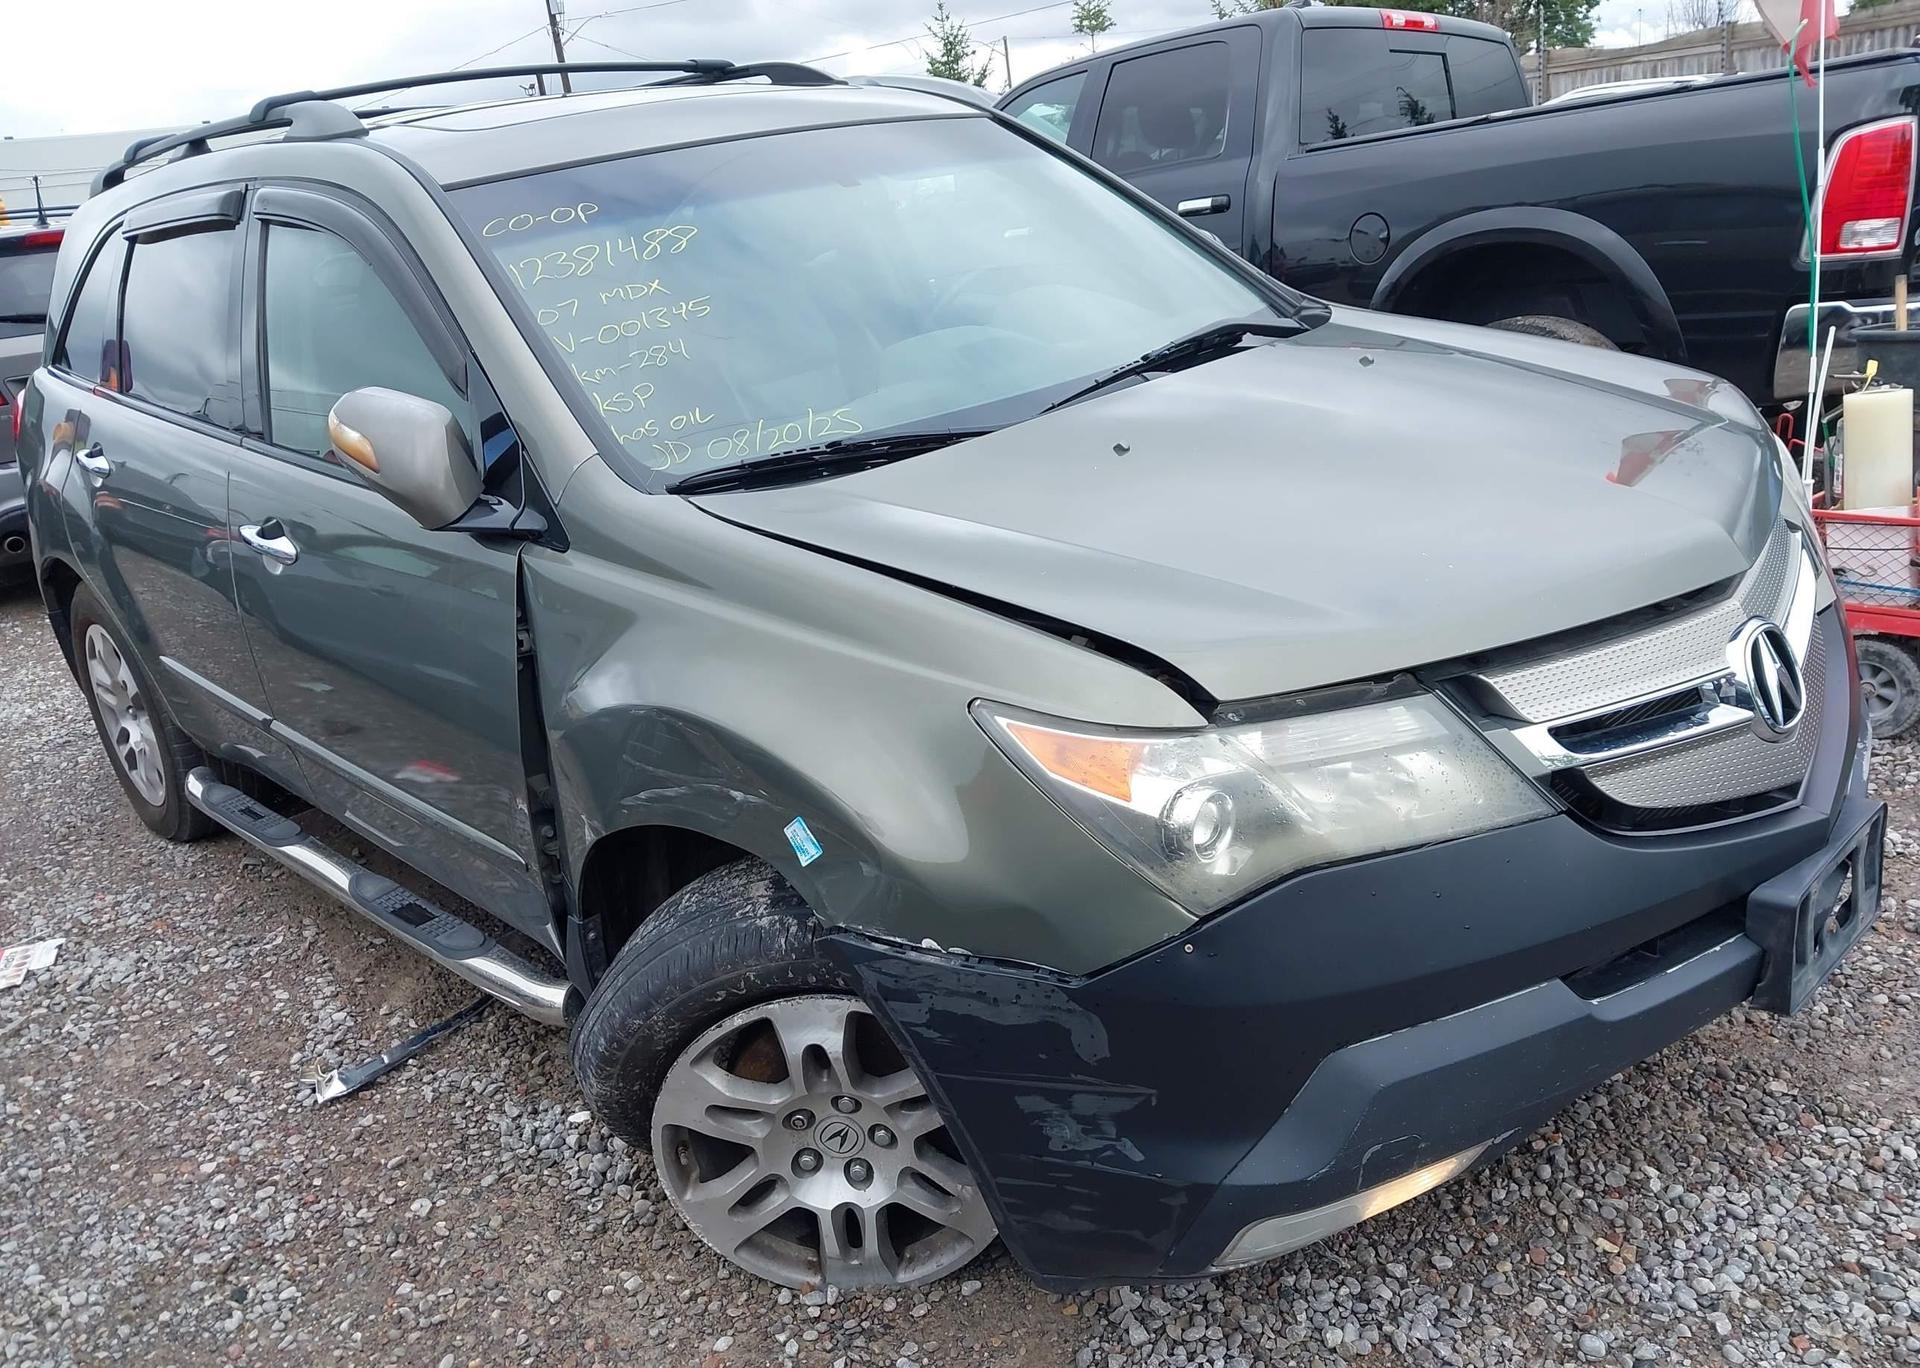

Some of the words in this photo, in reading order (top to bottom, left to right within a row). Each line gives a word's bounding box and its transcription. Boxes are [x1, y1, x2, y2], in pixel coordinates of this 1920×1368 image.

[482, 203, 598, 237] CO-OP
[509, 226, 697, 290] 12381488
[537, 299, 578, 326] 07
[553, 295, 711, 352] V-001345
[707, 408, 863, 460] 08/20/25
